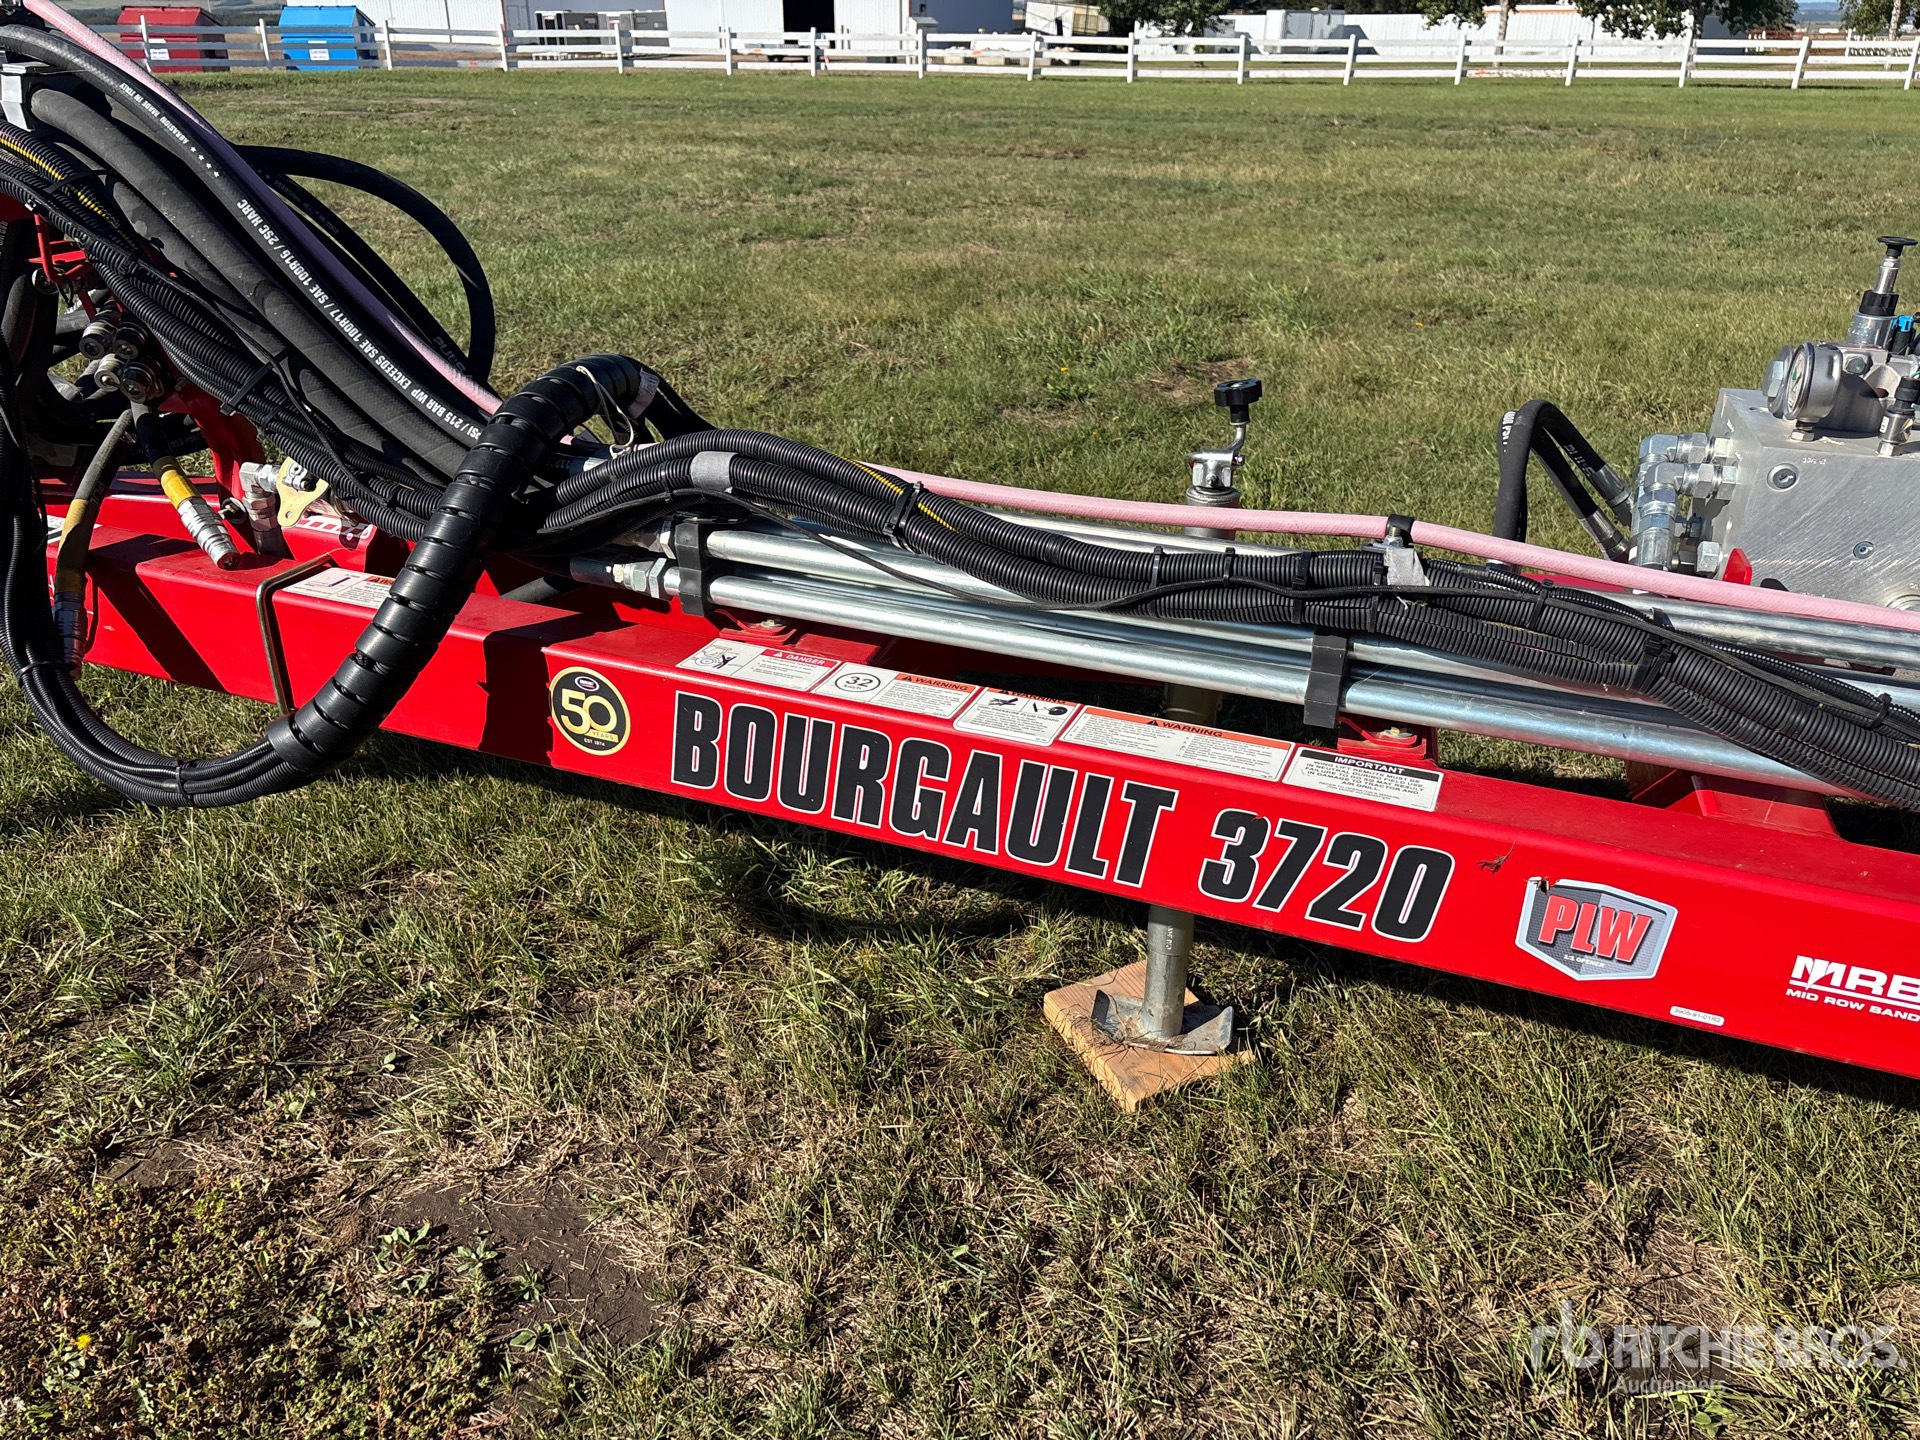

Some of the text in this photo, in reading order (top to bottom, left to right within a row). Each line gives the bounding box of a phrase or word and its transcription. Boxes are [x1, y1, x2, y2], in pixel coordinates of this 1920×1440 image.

[119, 82, 138, 98] ITALY
[133, 93, 144, 104] IN
[142, 100, 161, 118] MADE
[159, 115, 190, 145] ABRASION
[237, 199, 264, 227] HARC
[258, 224, 280, 246] 2SC
[280, 248, 313, 286] 100R16
[309, 283, 330, 304] SAE
[329, 308, 363, 342] 100R17
[359, 338, 379, 359] SAE
[375, 355, 412, 390] EXCEEDS
[411, 388, 429, 404] WP
[426, 400, 446, 418] BAR
[444, 413, 464, 428] 215
[785, 653, 826, 667] DANGER
[845, 675, 874, 688] 32
[916, 677, 969, 692] WARNING
[560, 688, 617, 735] 50
[592, 731, 614, 741] YEARS
[1162, 722, 1223, 738] WARNING
[1316, 765, 1350, 774] NEUTRAL
[1352, 772, 1381, 780] DURING
[1333, 756, 1405, 774] IMPORTANT
[1353, 768, 1384, 776] REMOTE
[1316, 773, 1349, 781] DAMAGE
[1364, 782, 1400, 791] TRACTOR
[1394, 783, 1424, 791] RESULT
[672, 690, 1455, 943] BOURGAULT 3720
[1538, 894, 1652, 963] PLW
[1576, 957, 1605, 969] OPENER
[1785, 988, 1819, 1002] MID
[1823, 996, 1865, 1011] ROW
